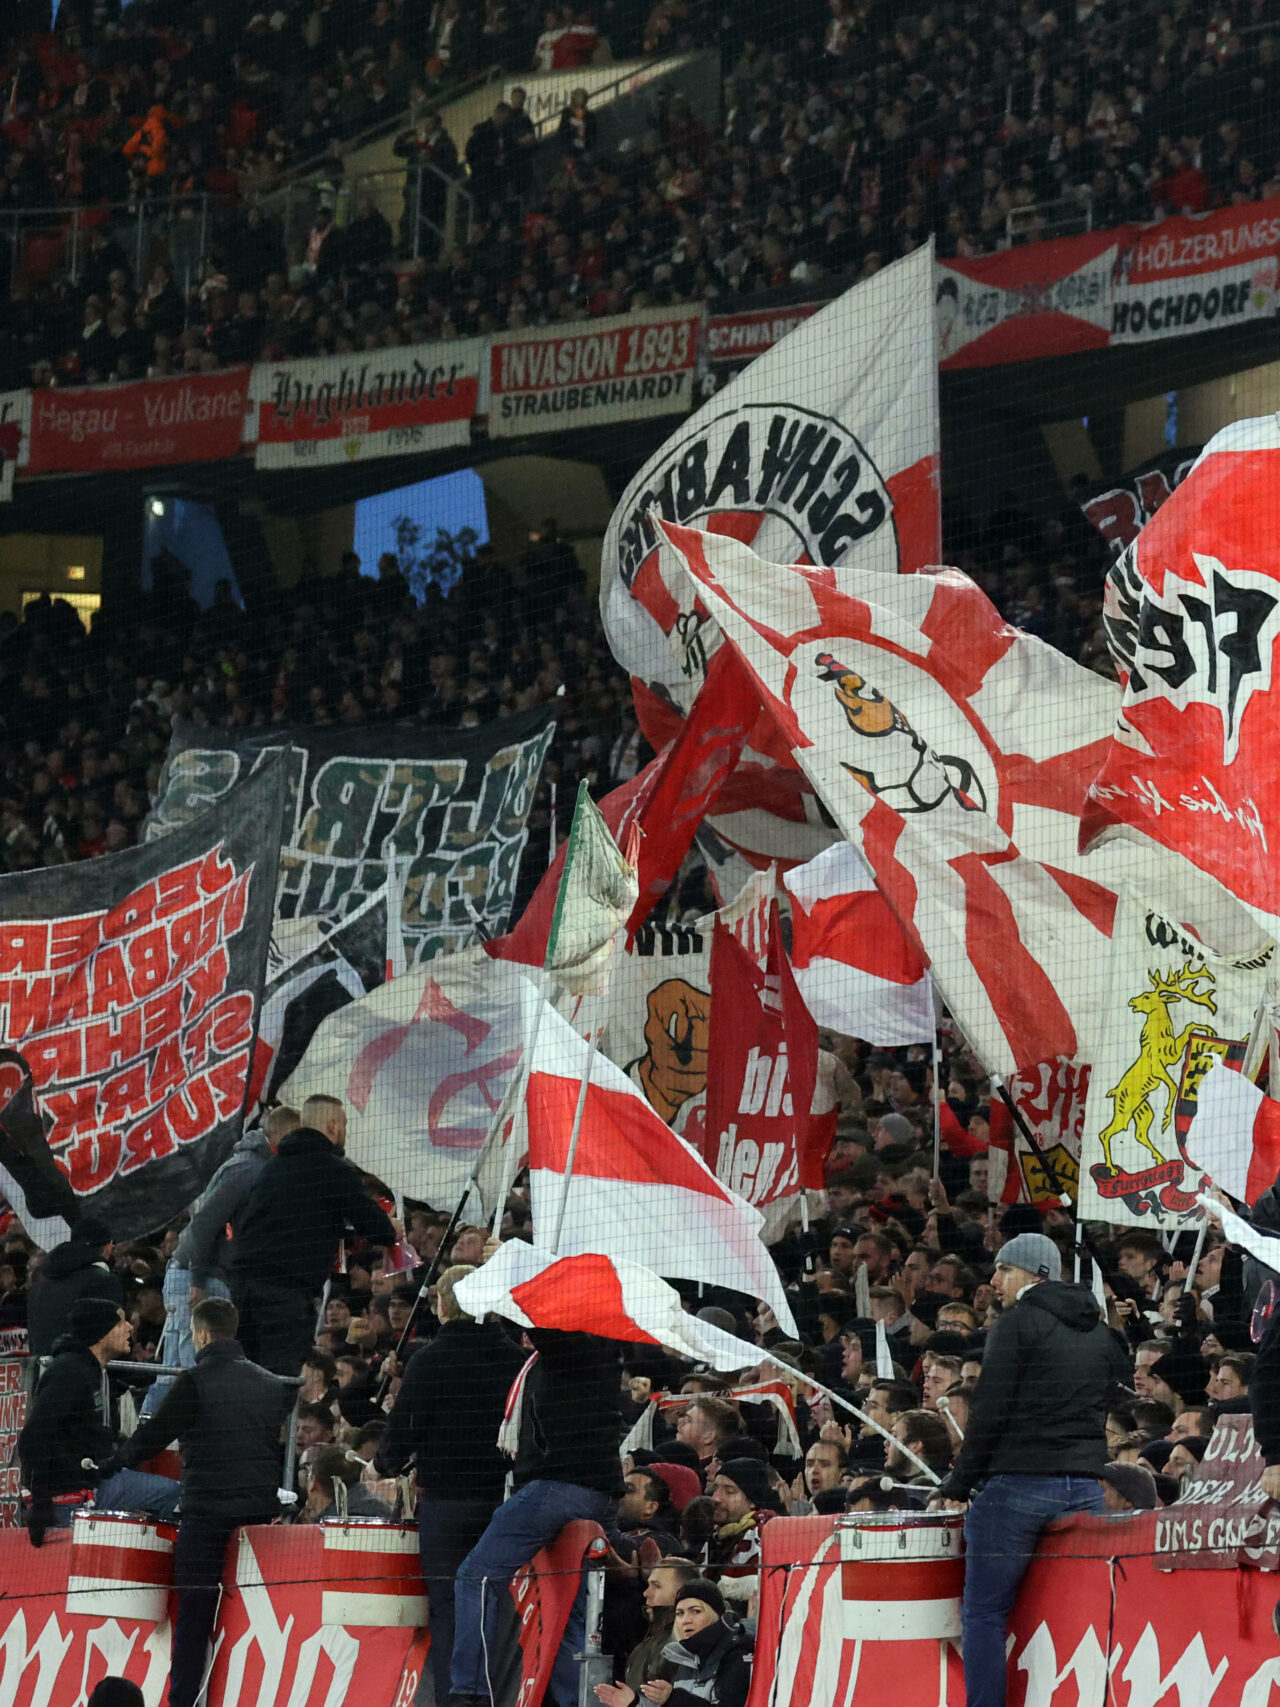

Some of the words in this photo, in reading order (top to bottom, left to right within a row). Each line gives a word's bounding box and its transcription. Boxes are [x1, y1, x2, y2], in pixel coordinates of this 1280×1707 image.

[1112, 279, 1254, 335] HOCHDORF
[501, 332, 619, 391] INVASION
[623, 320, 692, 373] 1893
[143, 386, 242, 427] Vulkane
[501, 370, 687, 419] STRAUBENHARDT
[1155, 1518, 1203, 1557] UMS
